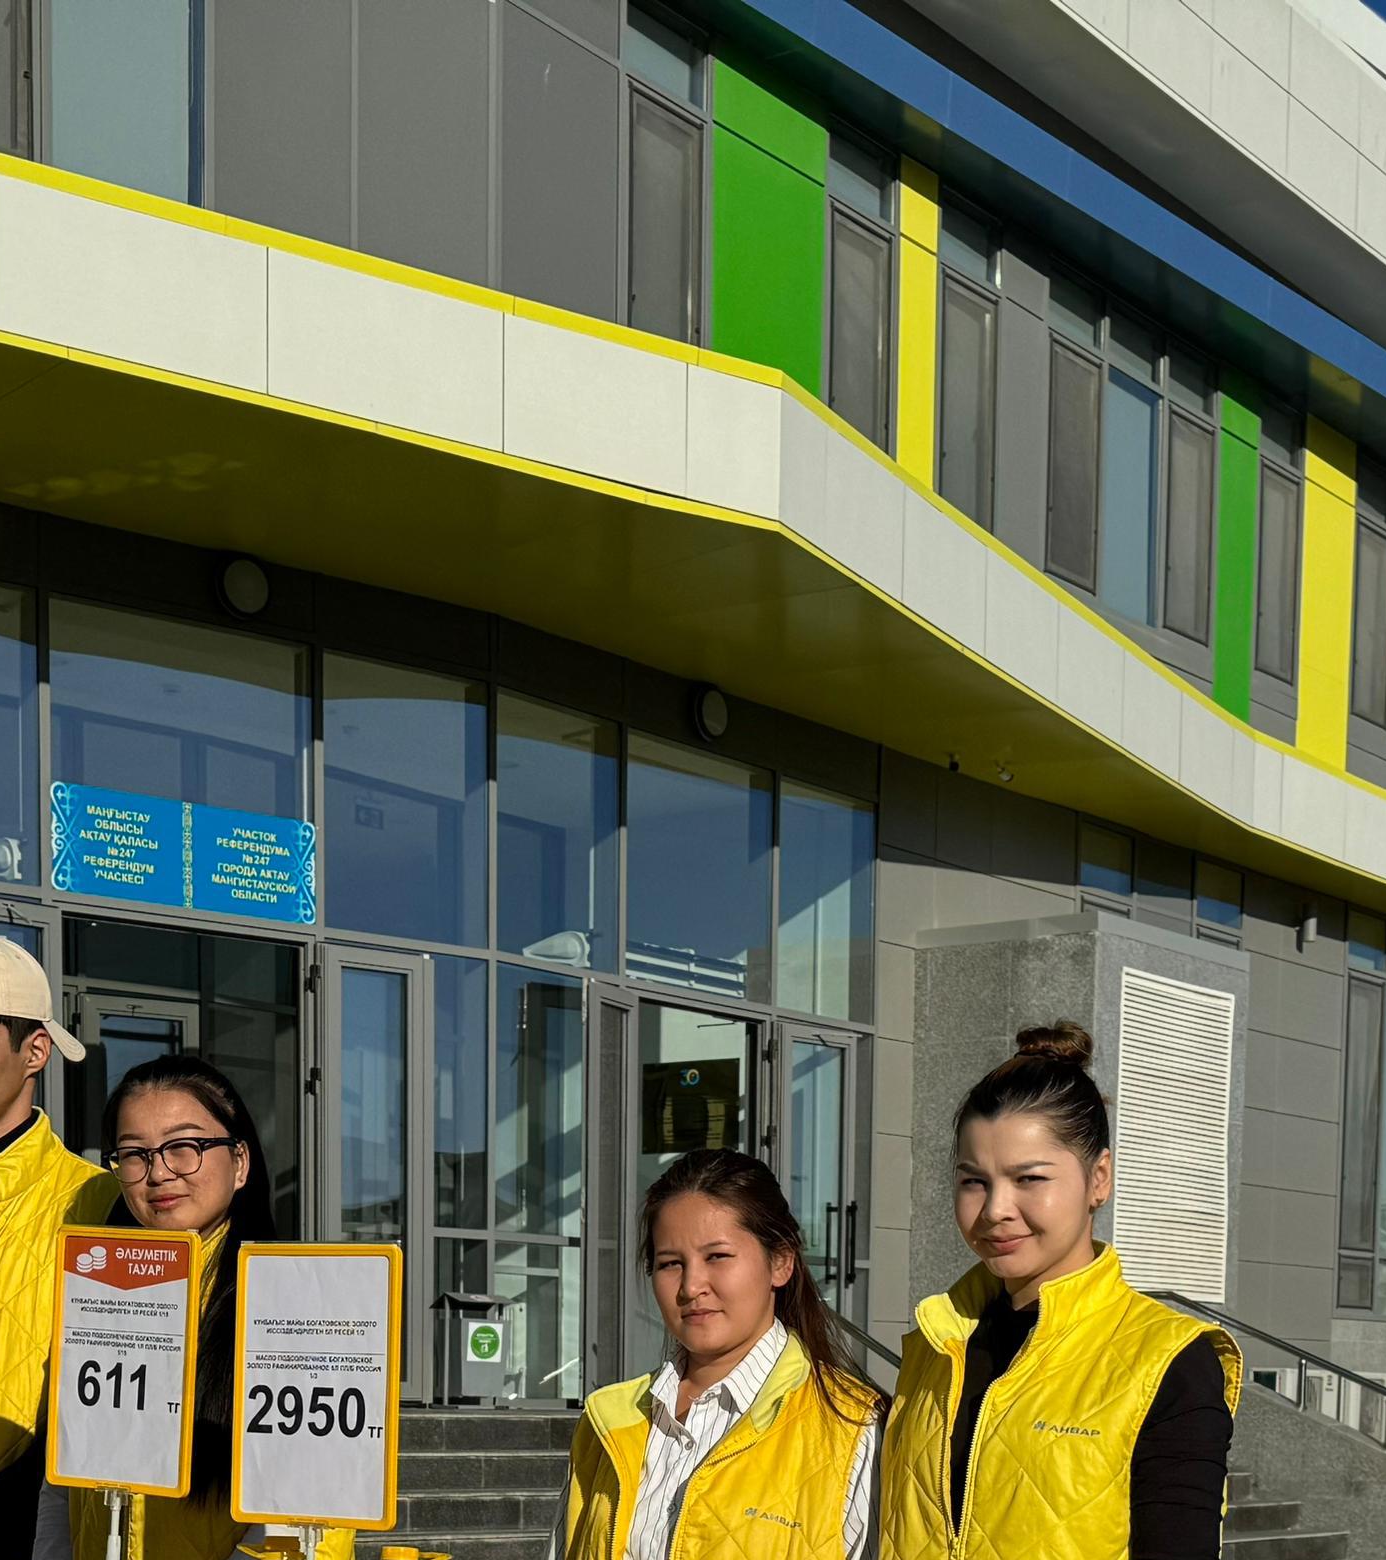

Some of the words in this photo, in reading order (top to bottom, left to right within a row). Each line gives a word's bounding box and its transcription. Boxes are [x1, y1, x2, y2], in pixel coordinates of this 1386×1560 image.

[87, 805, 150, 823] МАҢҒЫСТАУ
[95, 820, 143, 835] ОБЛЫСЫ
[232, 828, 277, 843] УЧАСТОК
[114, 834, 158, 850] ҚАЛАСЫ
[216, 837, 290, 857] РЕФЕРЕНДУМА
[83, 855, 154, 874] РЕФЕРЕНДУМ
[217, 863, 257, 878] ГОРОДА
[260, 868, 290, 881] АКТАУ
[93, 869, 144, 885] УЧАСКЕСІ
[211, 873, 297, 894] МАНГИСТАУСКОЙ
[231, 889, 278, 904] ОБЛАСТИ
[115, 1247, 177, 1262] ӘЛЕУМЕТТІК
[128, 1263, 165, 1276] ТАУАР!
[77, 1360, 147, 1411] 611
[246, 1384, 366, 1438] 2950
[1049, 1423, 1101, 1437] АНВАР
